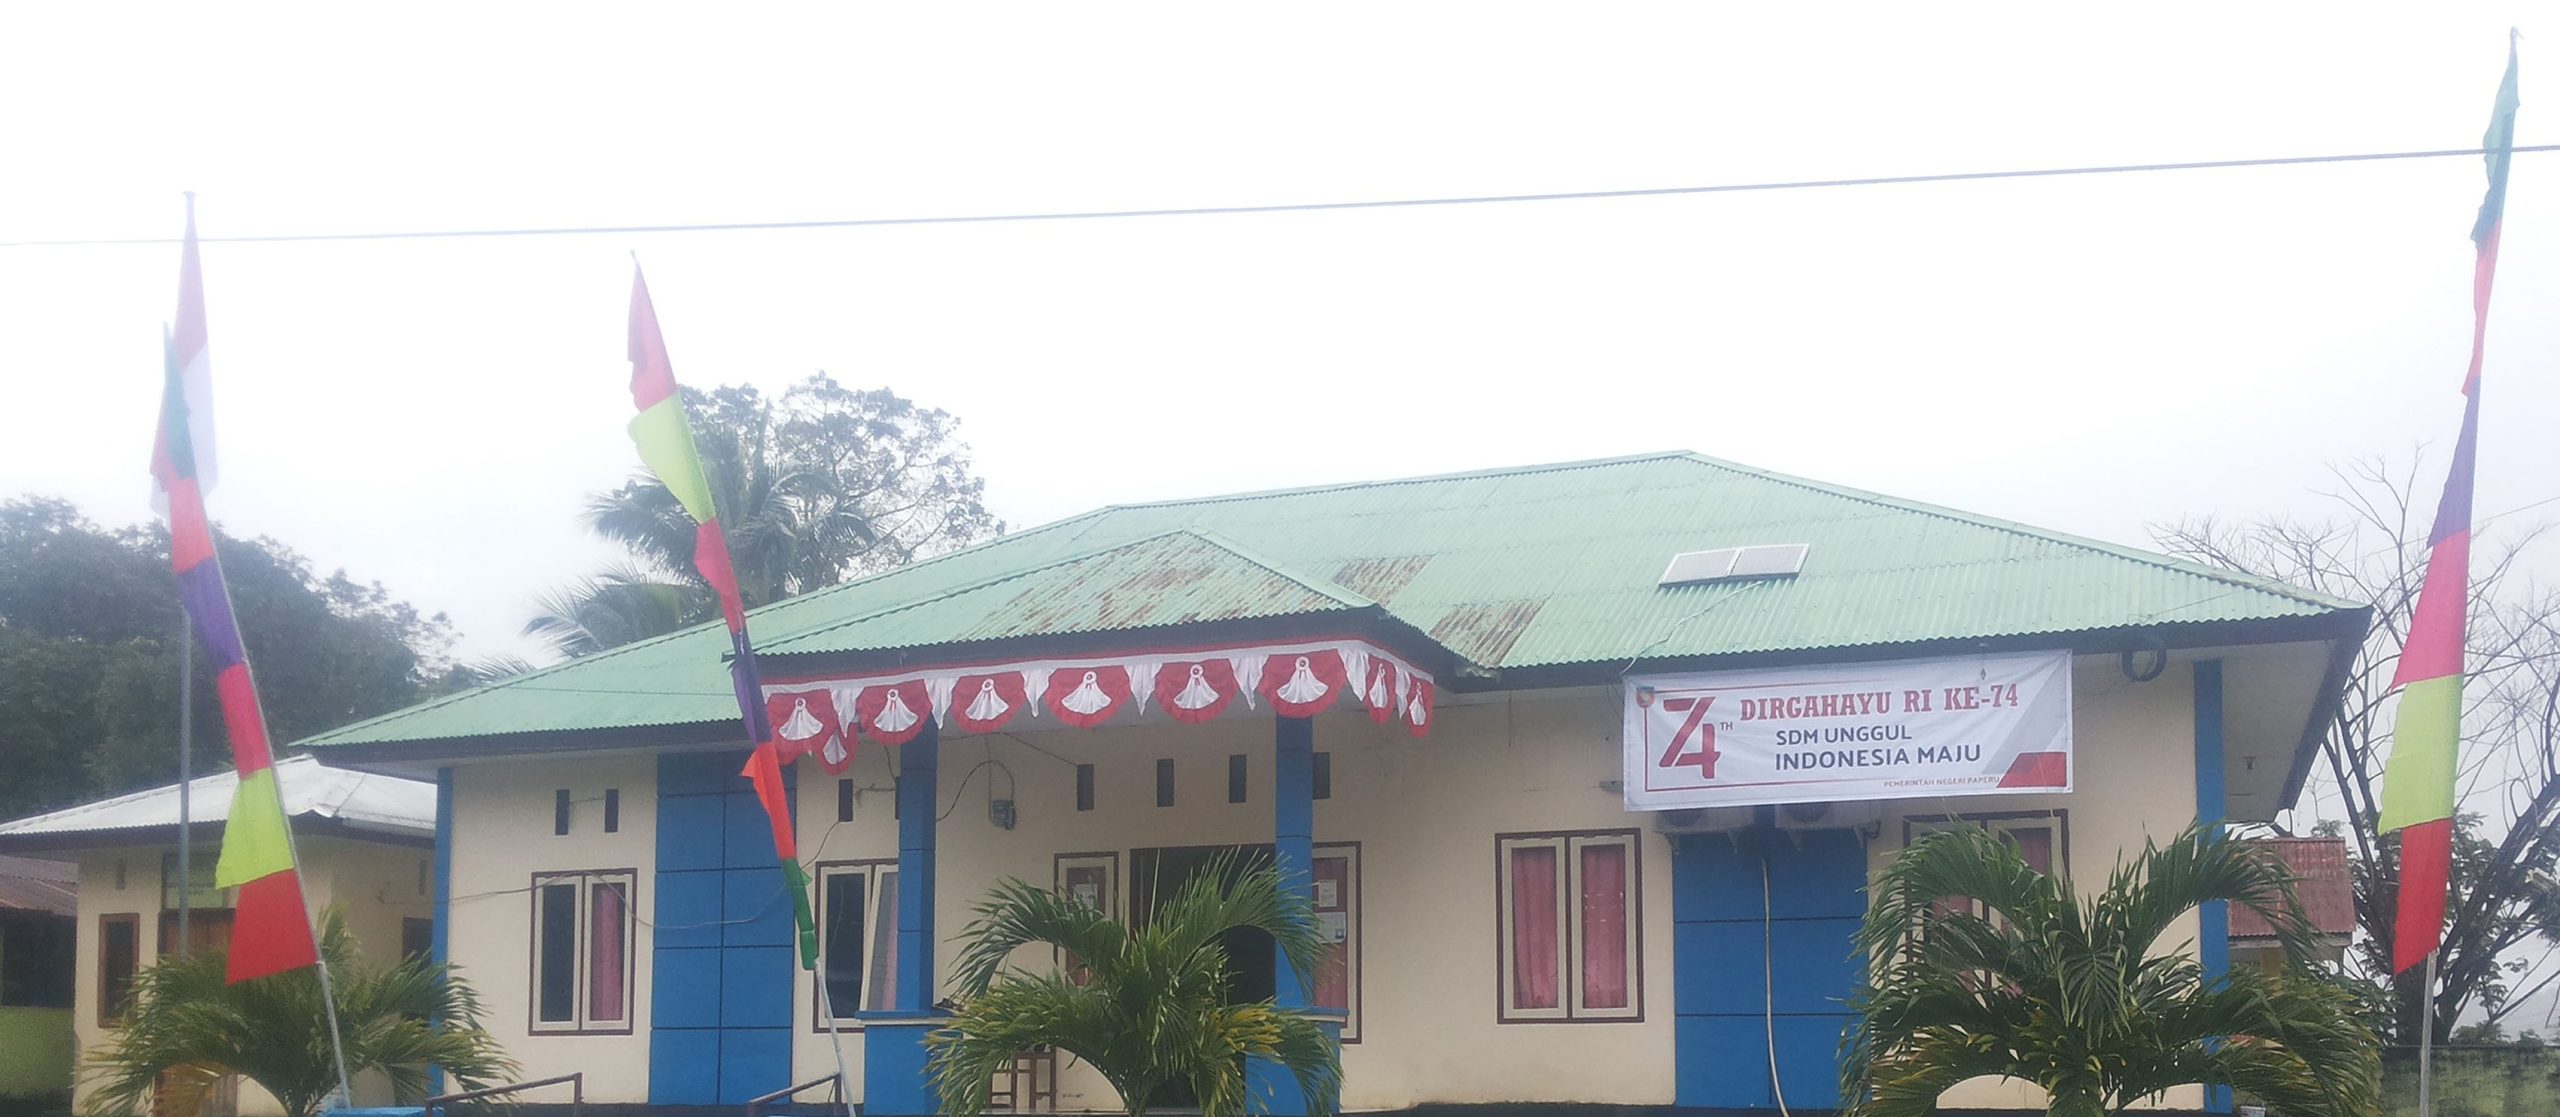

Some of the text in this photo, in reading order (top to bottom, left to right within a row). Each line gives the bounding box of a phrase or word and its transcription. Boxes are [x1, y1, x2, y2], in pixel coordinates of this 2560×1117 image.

[1740, 683, 2018, 721] DIRGAHAYU RI KE-74
[1720, 722, 1734, 731] TH
[1776, 724, 1913, 746] SDM UNGGUL
[1775, 744, 1981, 771] INDONESIA MAJU
[1883, 776, 2000, 788] PEMERINTAH NEGERI PAPERU
